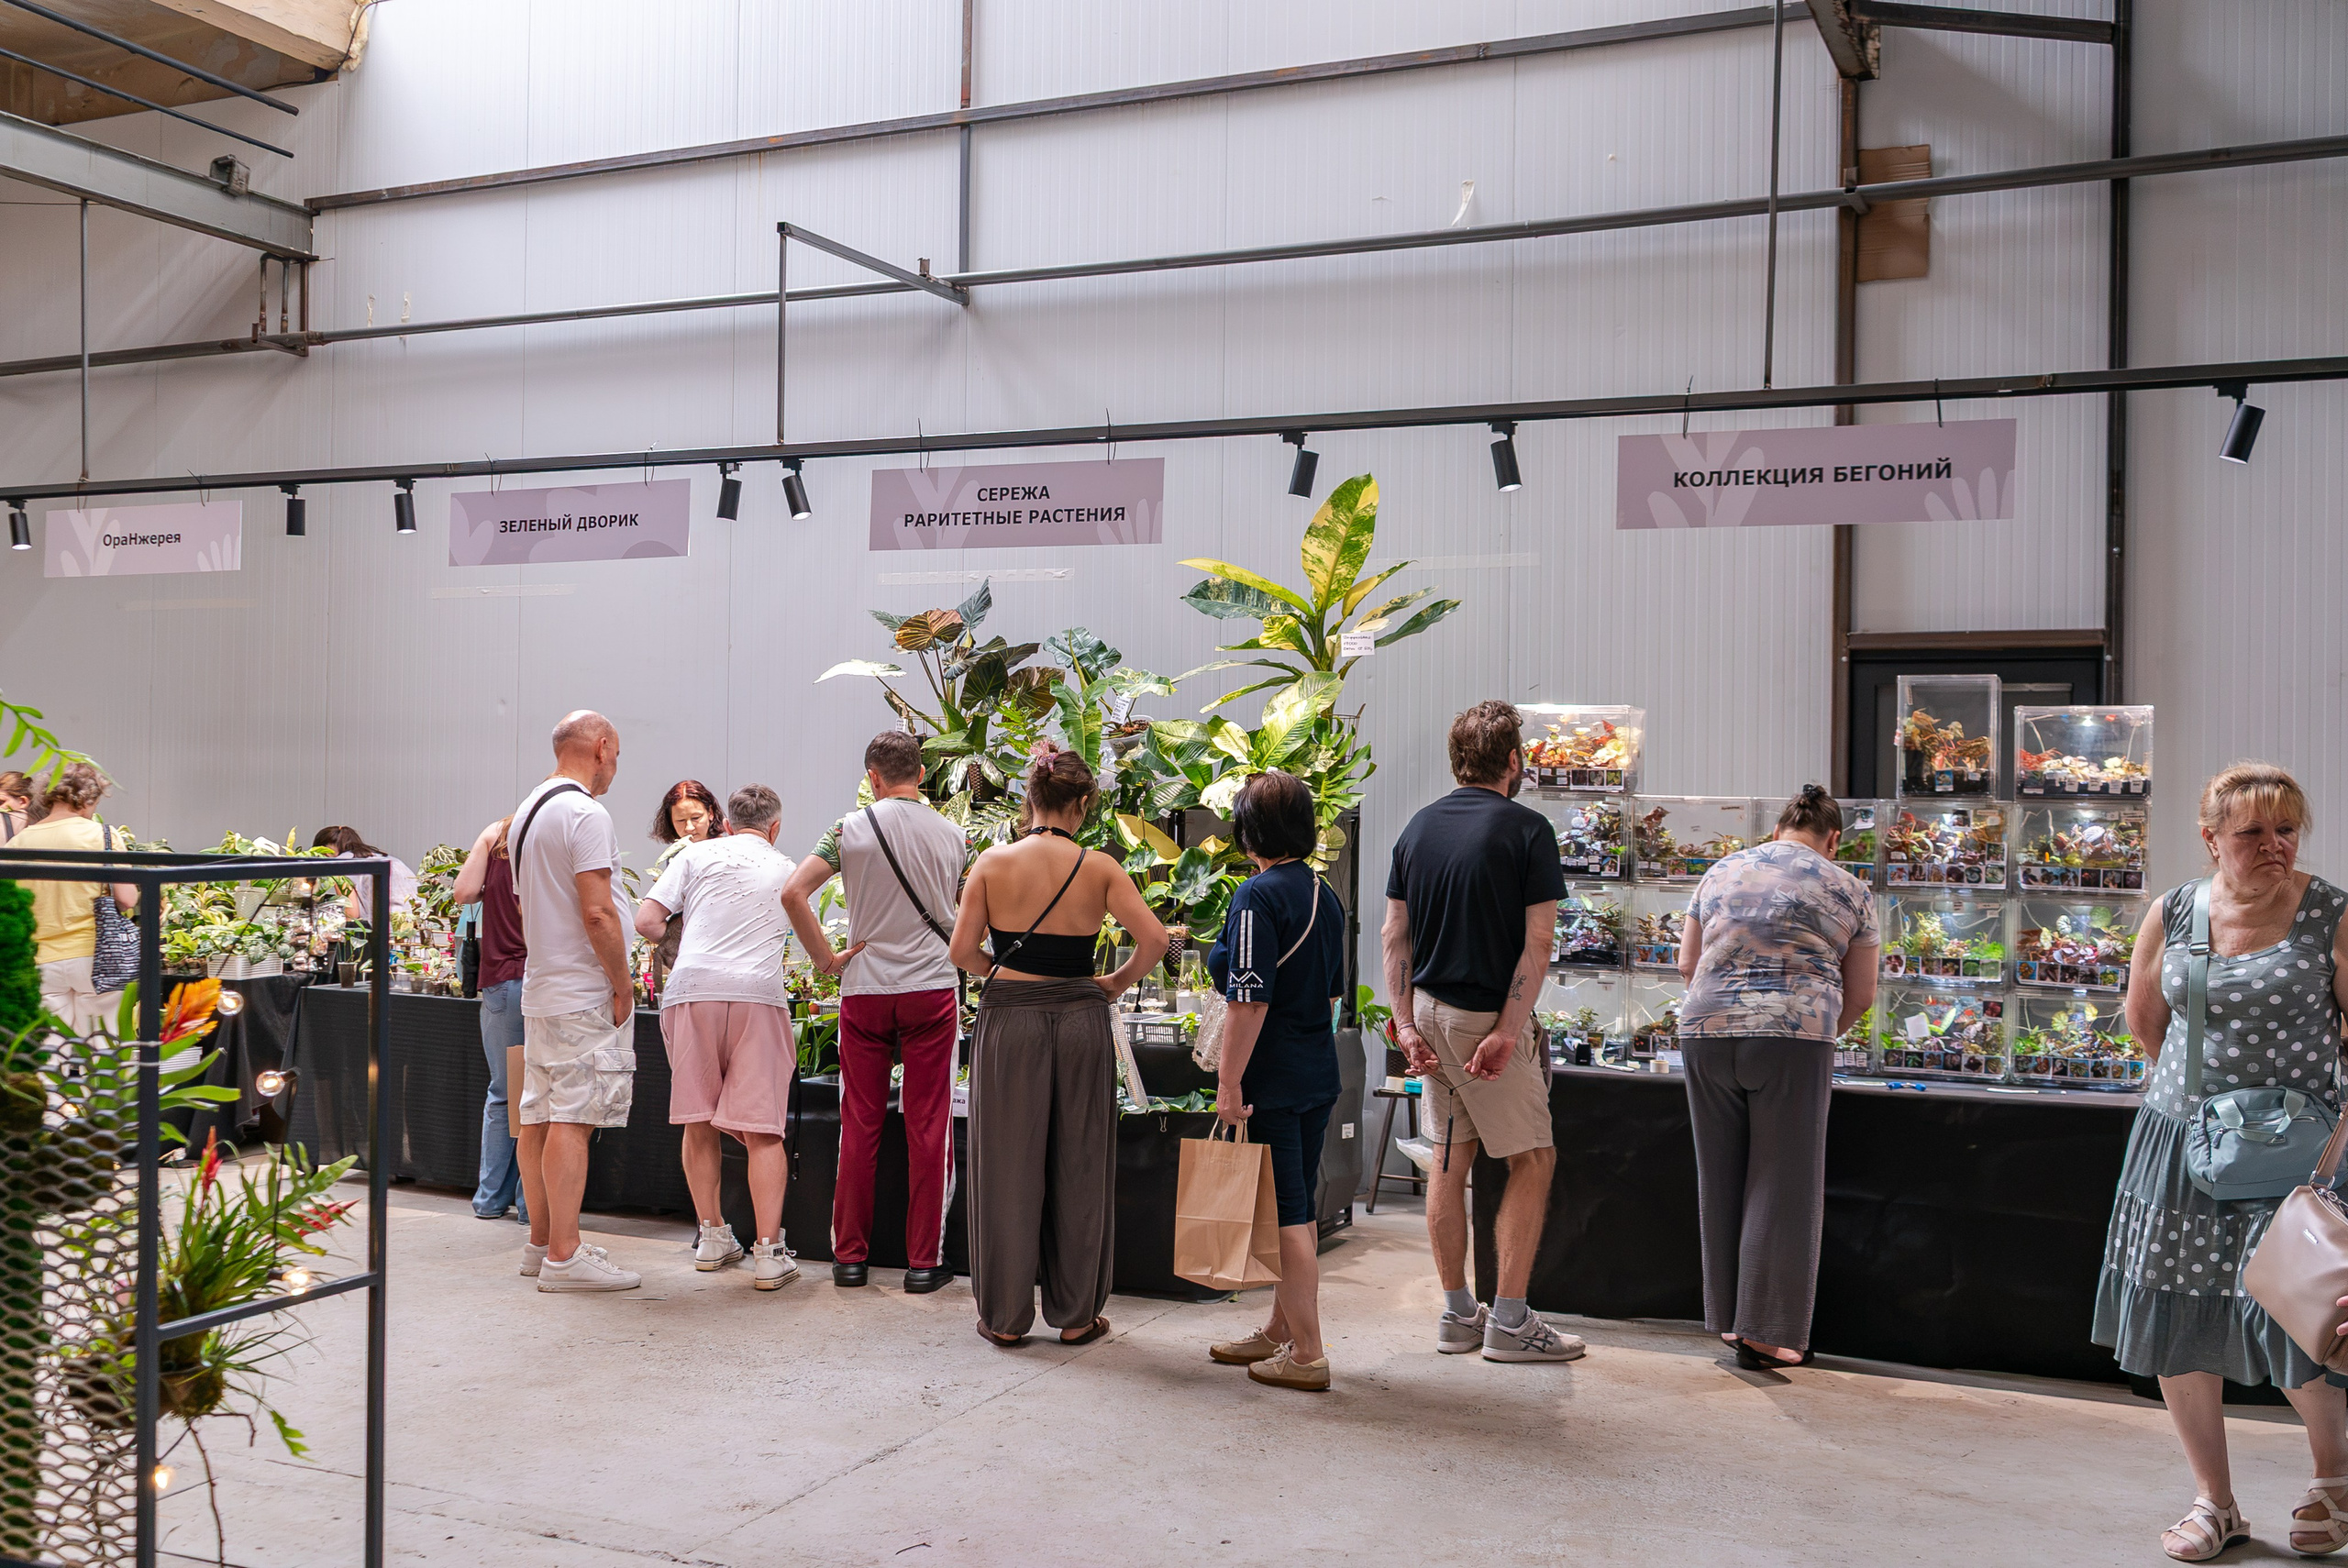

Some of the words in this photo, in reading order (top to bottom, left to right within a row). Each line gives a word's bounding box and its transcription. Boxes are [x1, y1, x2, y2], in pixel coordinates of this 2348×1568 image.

[1674, 467, 1824, 488] КОЛЛЕКЦИЯ
[1833, 457, 1952, 483] БЕГОНИЙ
[977, 485, 1050, 502] СЕРЕЖА
[499, 513, 572, 534] ЗЕЛЕНЫЙ
[576, 513, 639, 533] ДВОРИК
[903, 510, 1023, 527] РАРИТЕТНЫЕ
[1028, 506, 1125, 525] РАСТЕНИЯ
[103, 533, 182, 549] ОраНжерея
